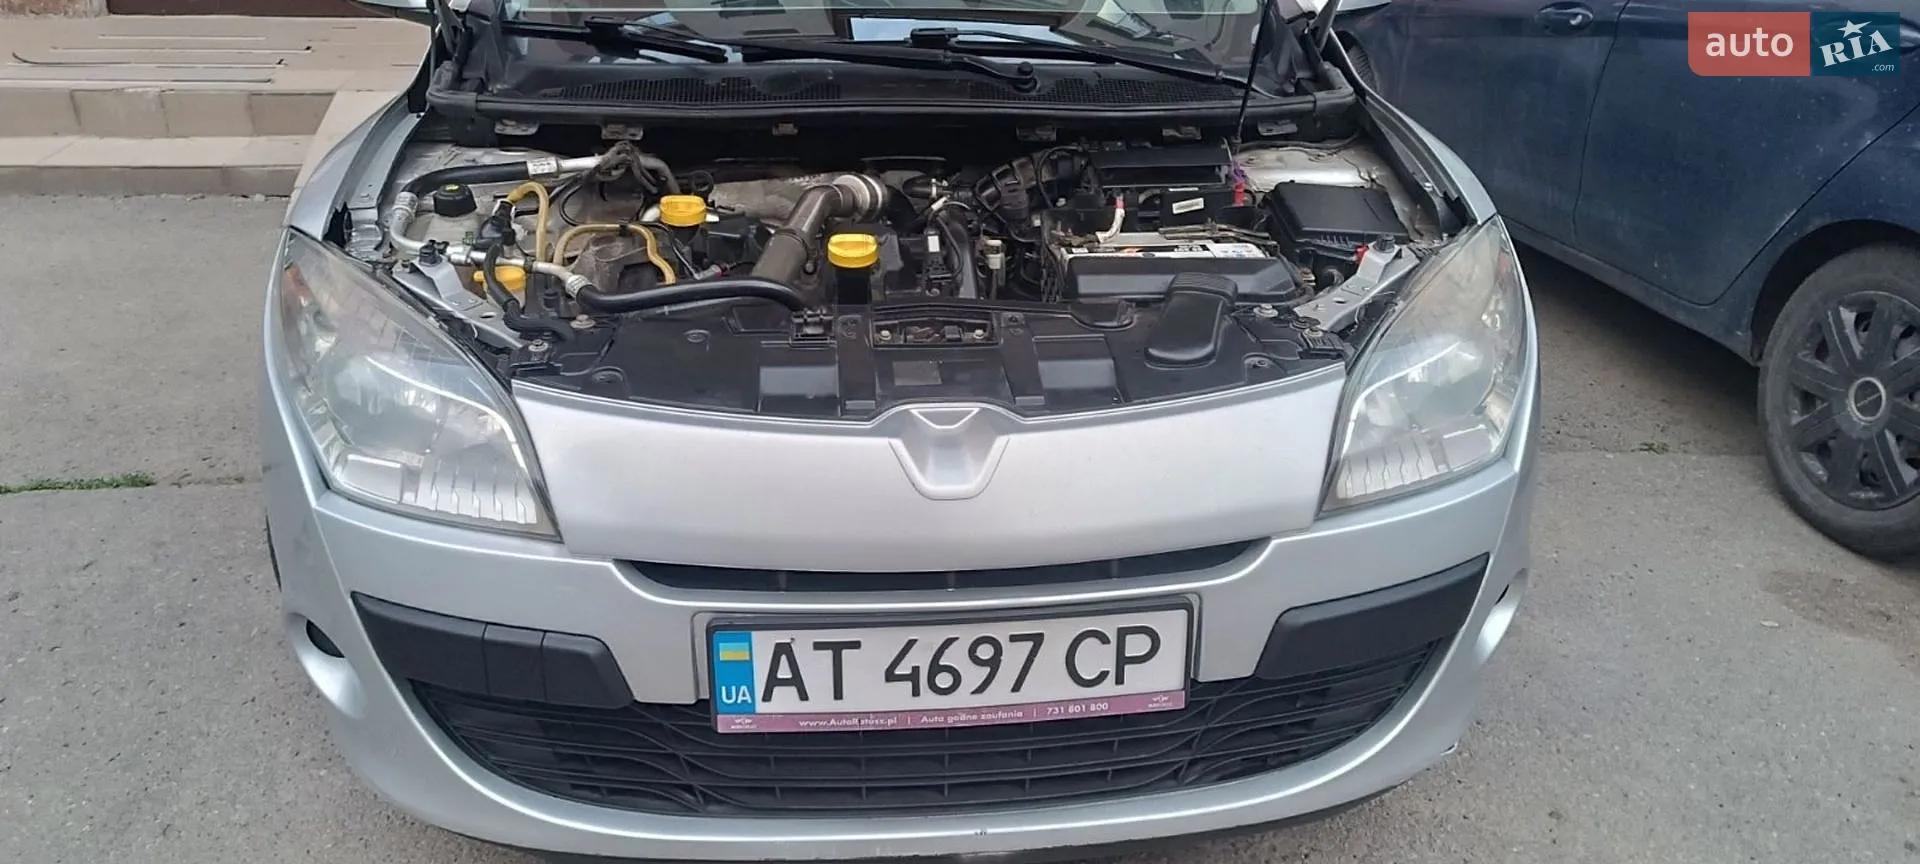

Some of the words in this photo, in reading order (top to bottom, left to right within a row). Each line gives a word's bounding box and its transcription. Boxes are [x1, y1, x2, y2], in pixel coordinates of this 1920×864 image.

[761, 640, 862, 702] AT
[884, 632, 1045, 697] 4697
[1065, 624, 1162, 688] CP
[721, 685, 752, 705] UA
[1047, 706, 1064, 716] 731
[1068, 704, 1087, 714] 801
[1090, 702, 1109, 712] 800
